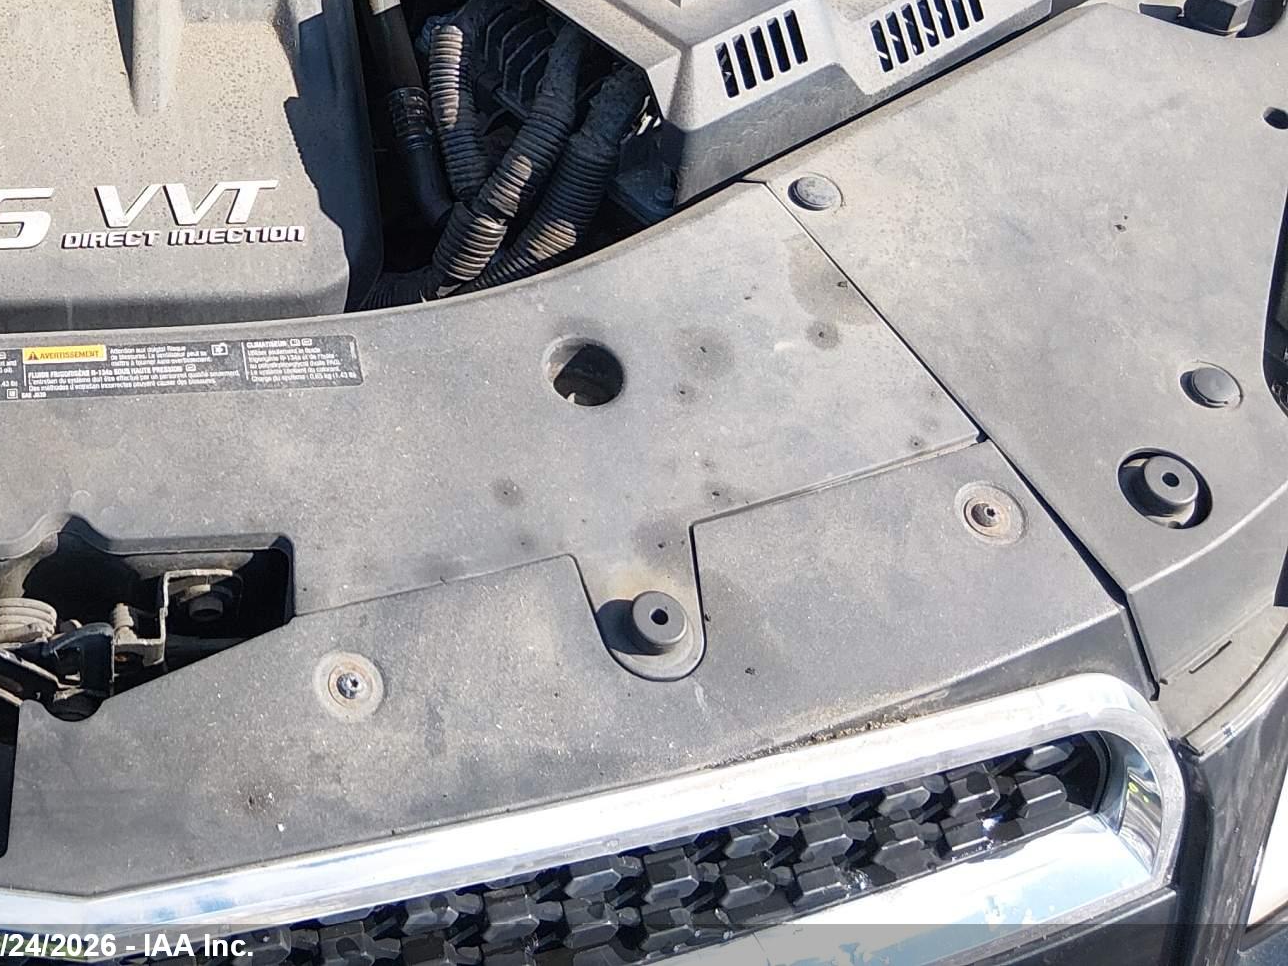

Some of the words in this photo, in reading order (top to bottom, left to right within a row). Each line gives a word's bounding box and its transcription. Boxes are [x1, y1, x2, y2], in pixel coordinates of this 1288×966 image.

[93, 179, 279, 228] VVT
[61, 230, 159, 249] DIRECT
[168, 225, 306, 246] INJECTION
[40, 350, 99, 360] AVERTISSEMENT
